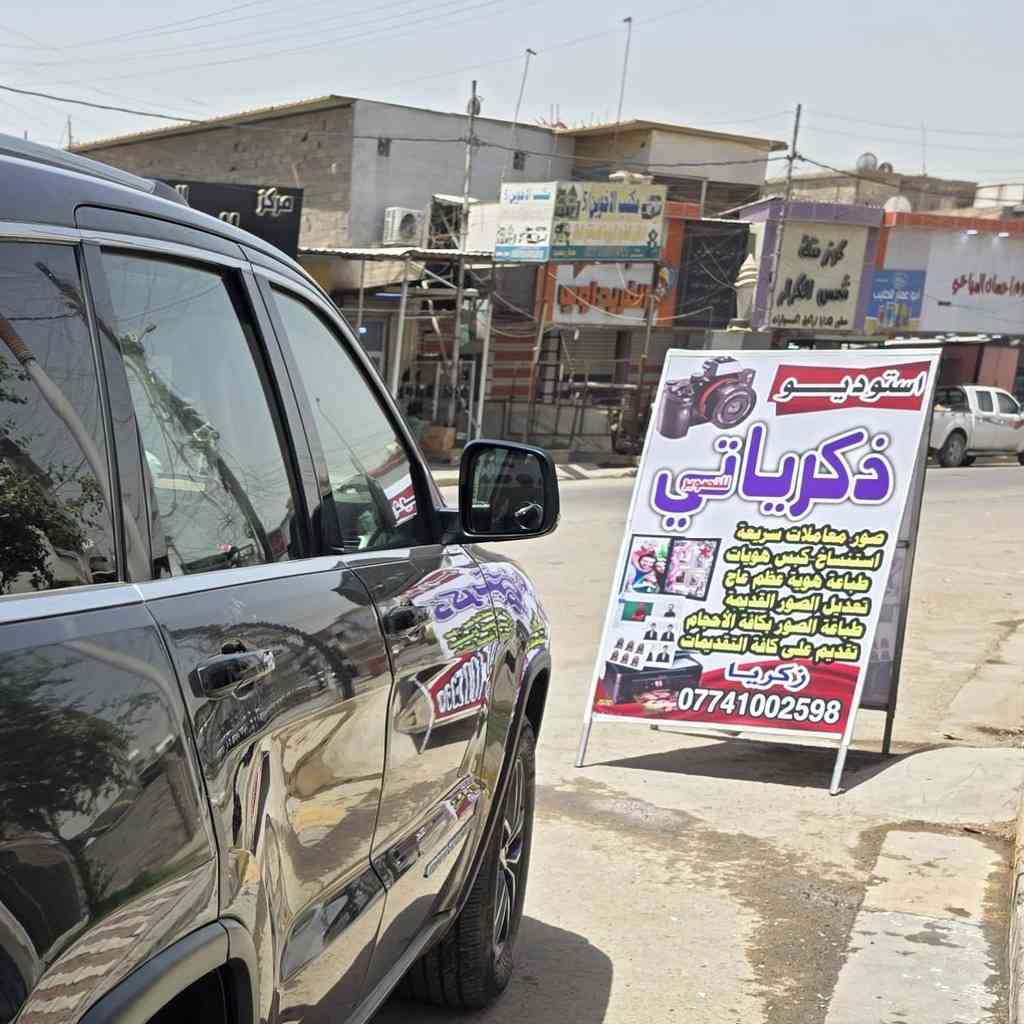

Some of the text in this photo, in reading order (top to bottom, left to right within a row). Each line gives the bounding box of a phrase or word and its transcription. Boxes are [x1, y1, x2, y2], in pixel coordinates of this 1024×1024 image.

[776, 370, 925, 402] استوديو
[654, 425, 890, 528] ذكرياتي
[734, 521, 888, 548] صور معاملات سريعة
[786, 570, 824, 592] هوية
[825, 572, 871, 593] طباعة
[775, 595, 821, 613] الصور
[821, 595, 870, 615] تعديل
[775, 618, 819, 636] الصور
[820, 618, 866, 638] طباعة
[749, 636, 780, 655] كافة
[781, 641, 815, 659] على
[815, 645, 860, 663] تقديم
[678, 687, 842, 724] 07741002598
